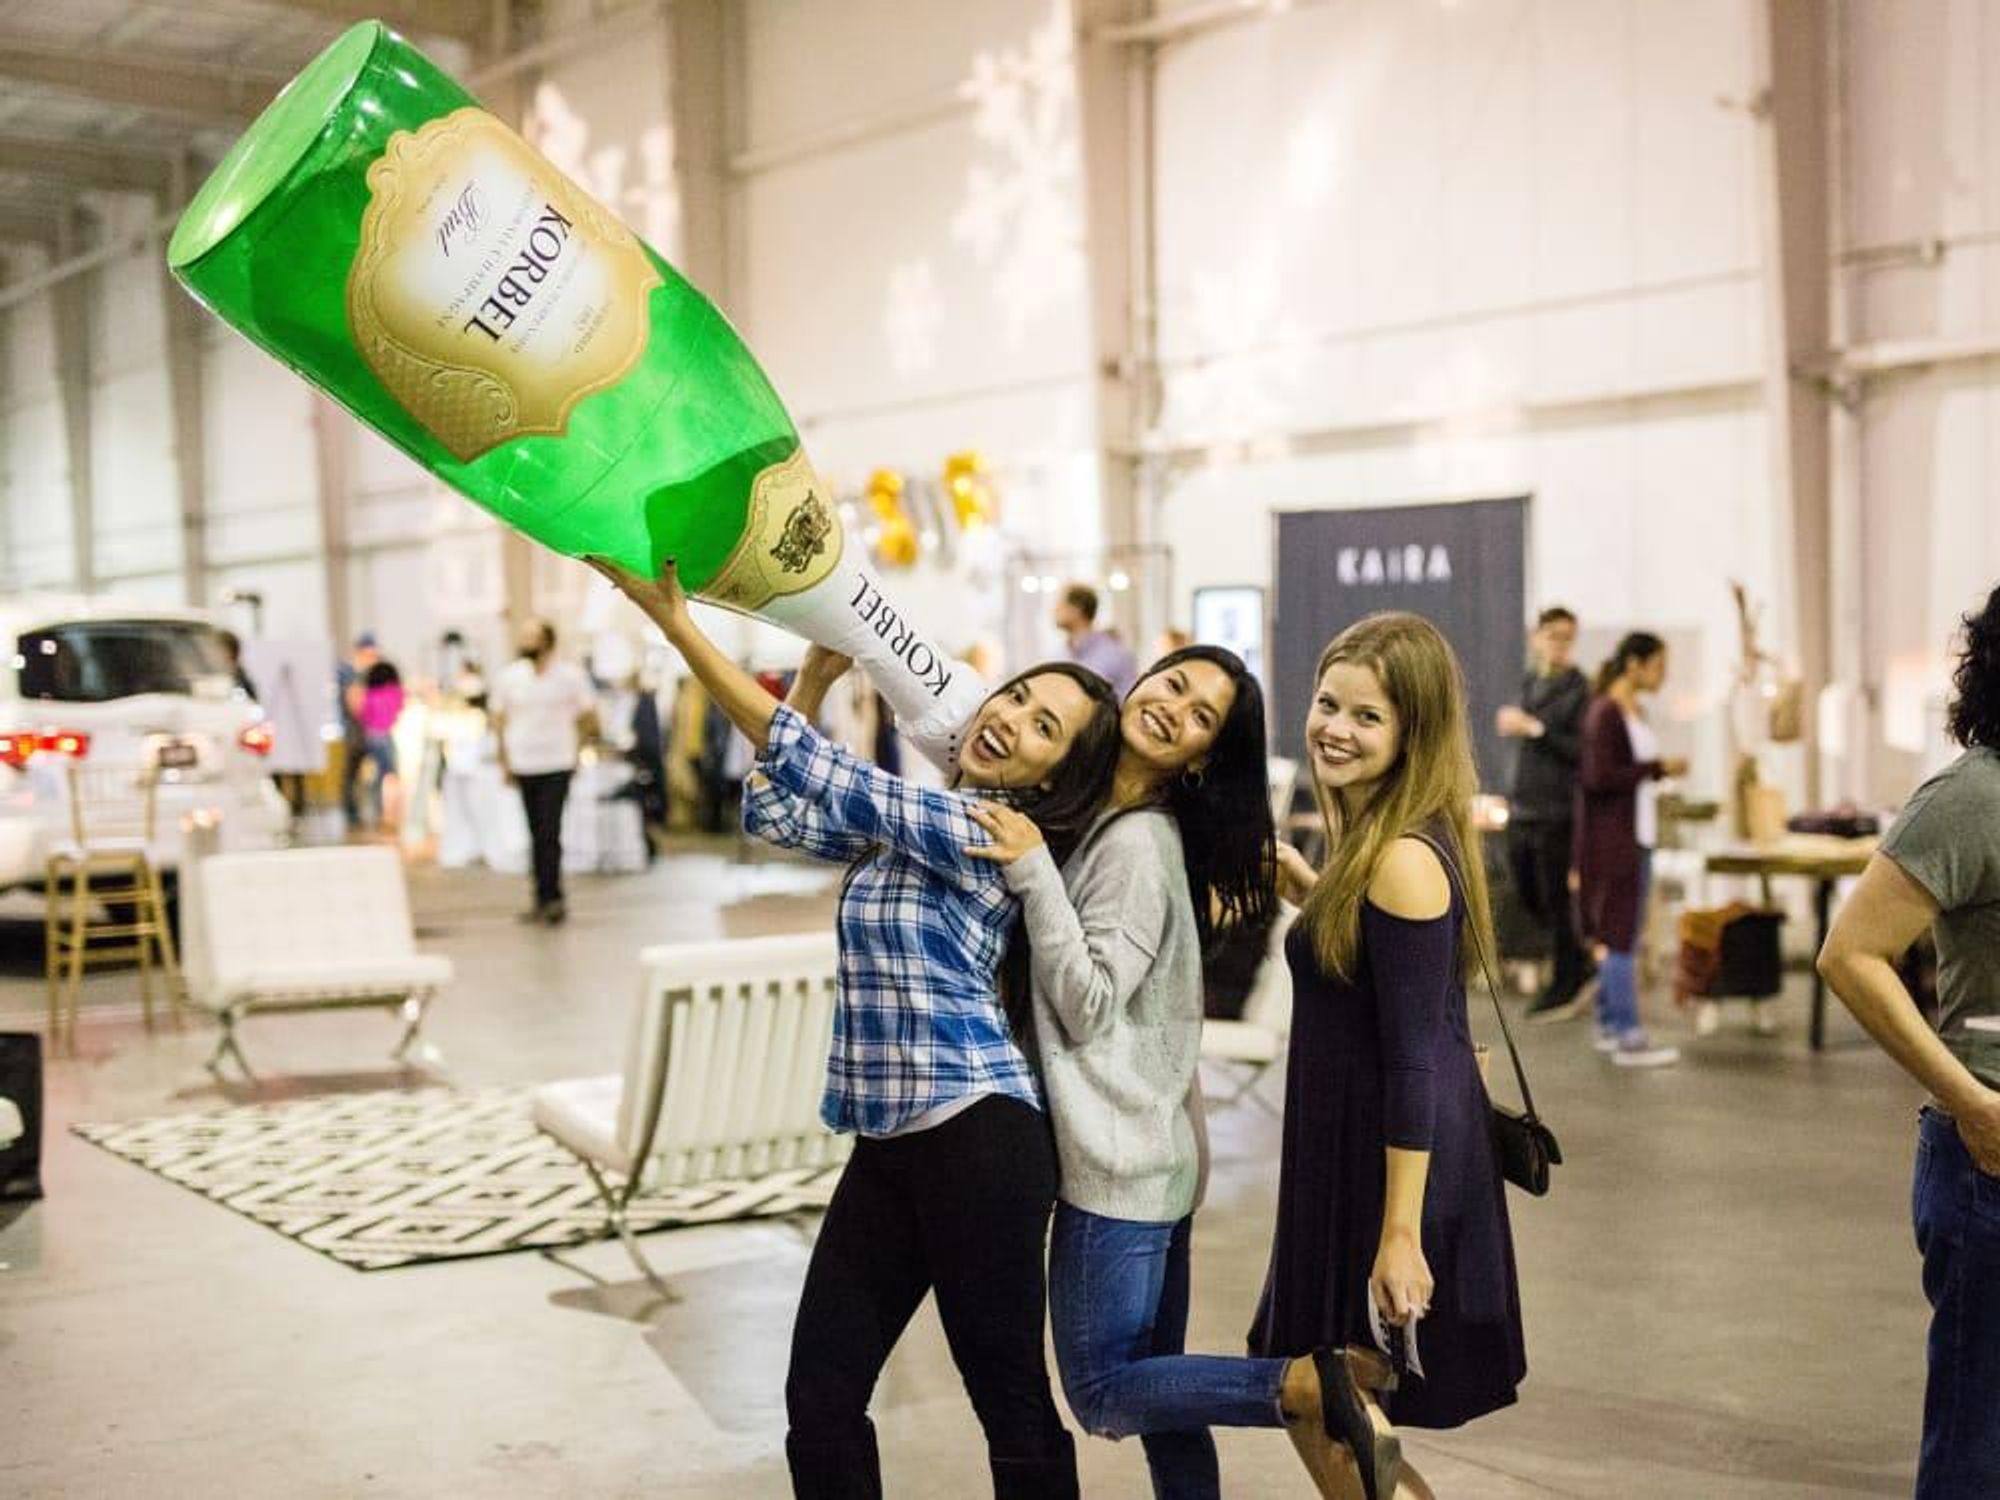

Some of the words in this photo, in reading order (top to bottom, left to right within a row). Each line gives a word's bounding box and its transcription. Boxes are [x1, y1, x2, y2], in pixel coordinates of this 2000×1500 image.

[436, 178, 483, 257] Brut
[463, 203, 573, 342] KORBEL
[850, 572, 952, 697] KORBEL
